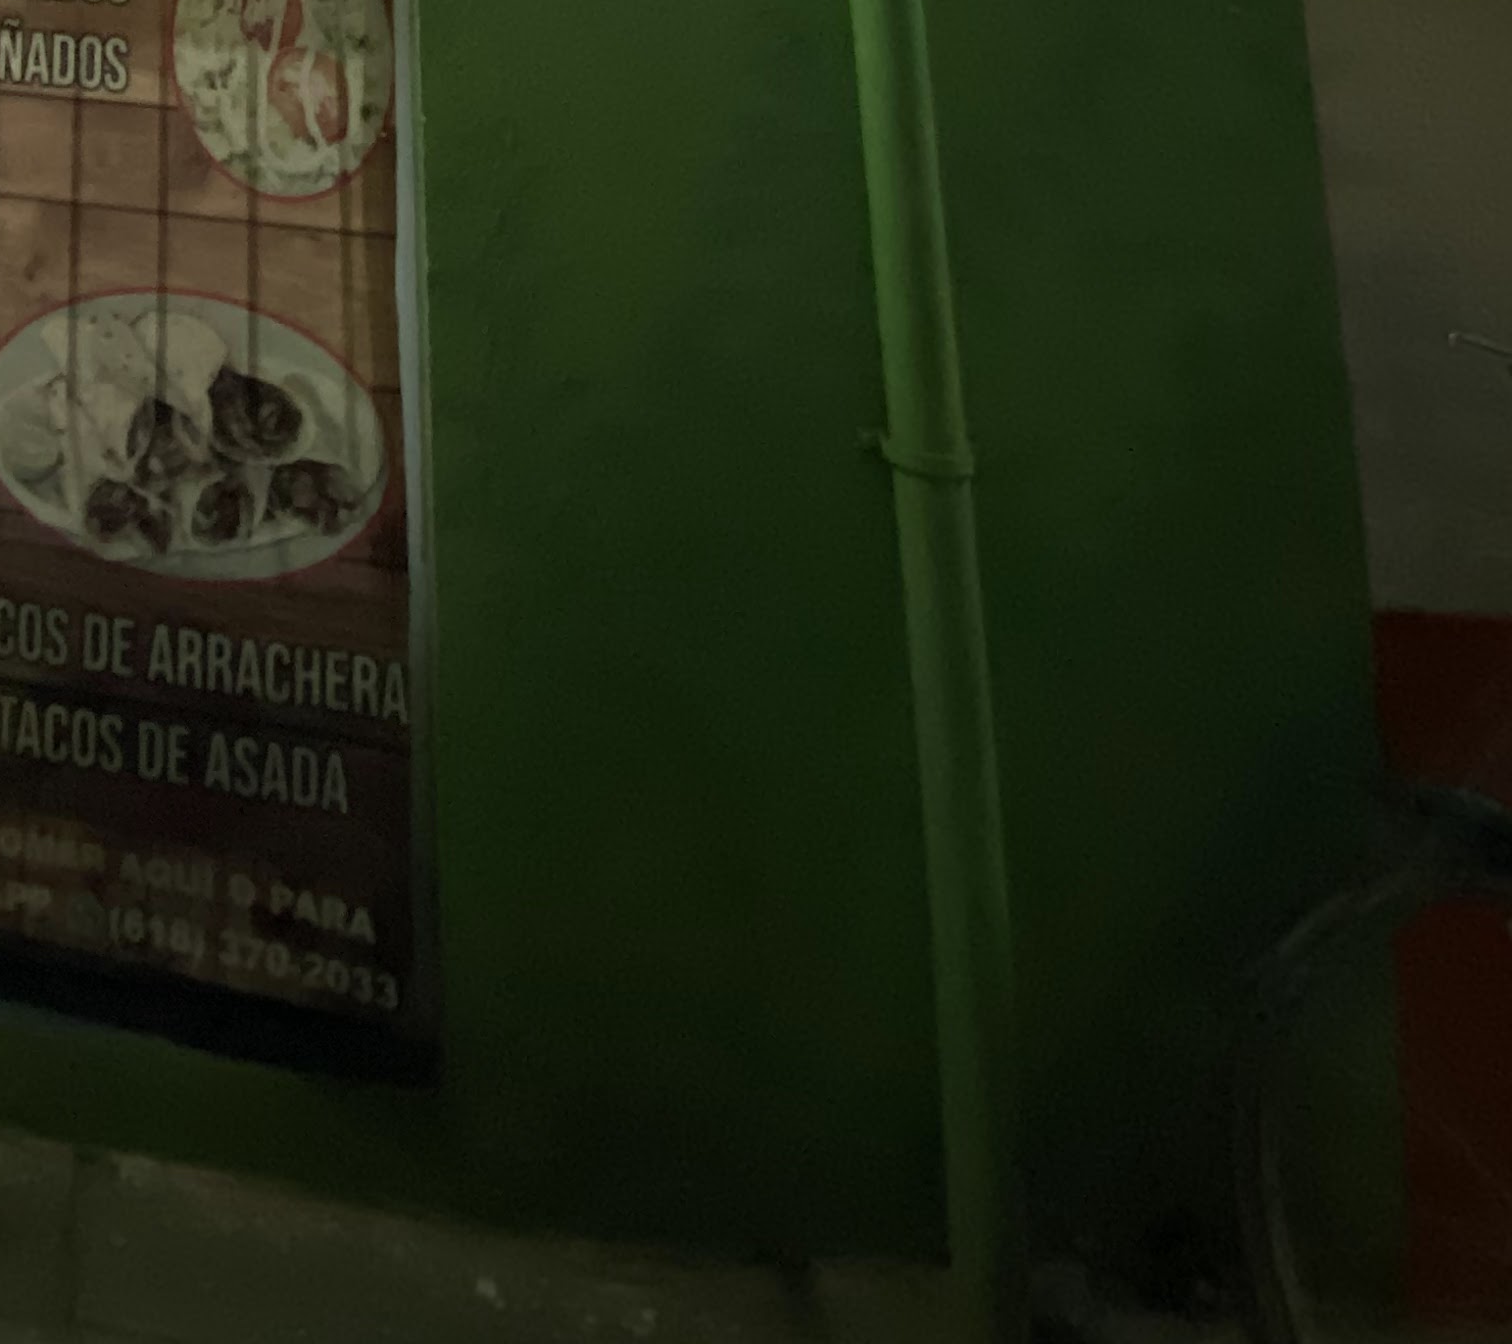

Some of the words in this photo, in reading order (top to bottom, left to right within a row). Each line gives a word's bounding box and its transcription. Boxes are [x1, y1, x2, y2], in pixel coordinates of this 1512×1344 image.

[83, 613, 135, 679] DE
[147, 622, 409, 724] ARRACHERA
[137, 719, 190, 787] DE
[204, 730, 350, 815] ASADA
[270, 881, 377, 945] PARA
